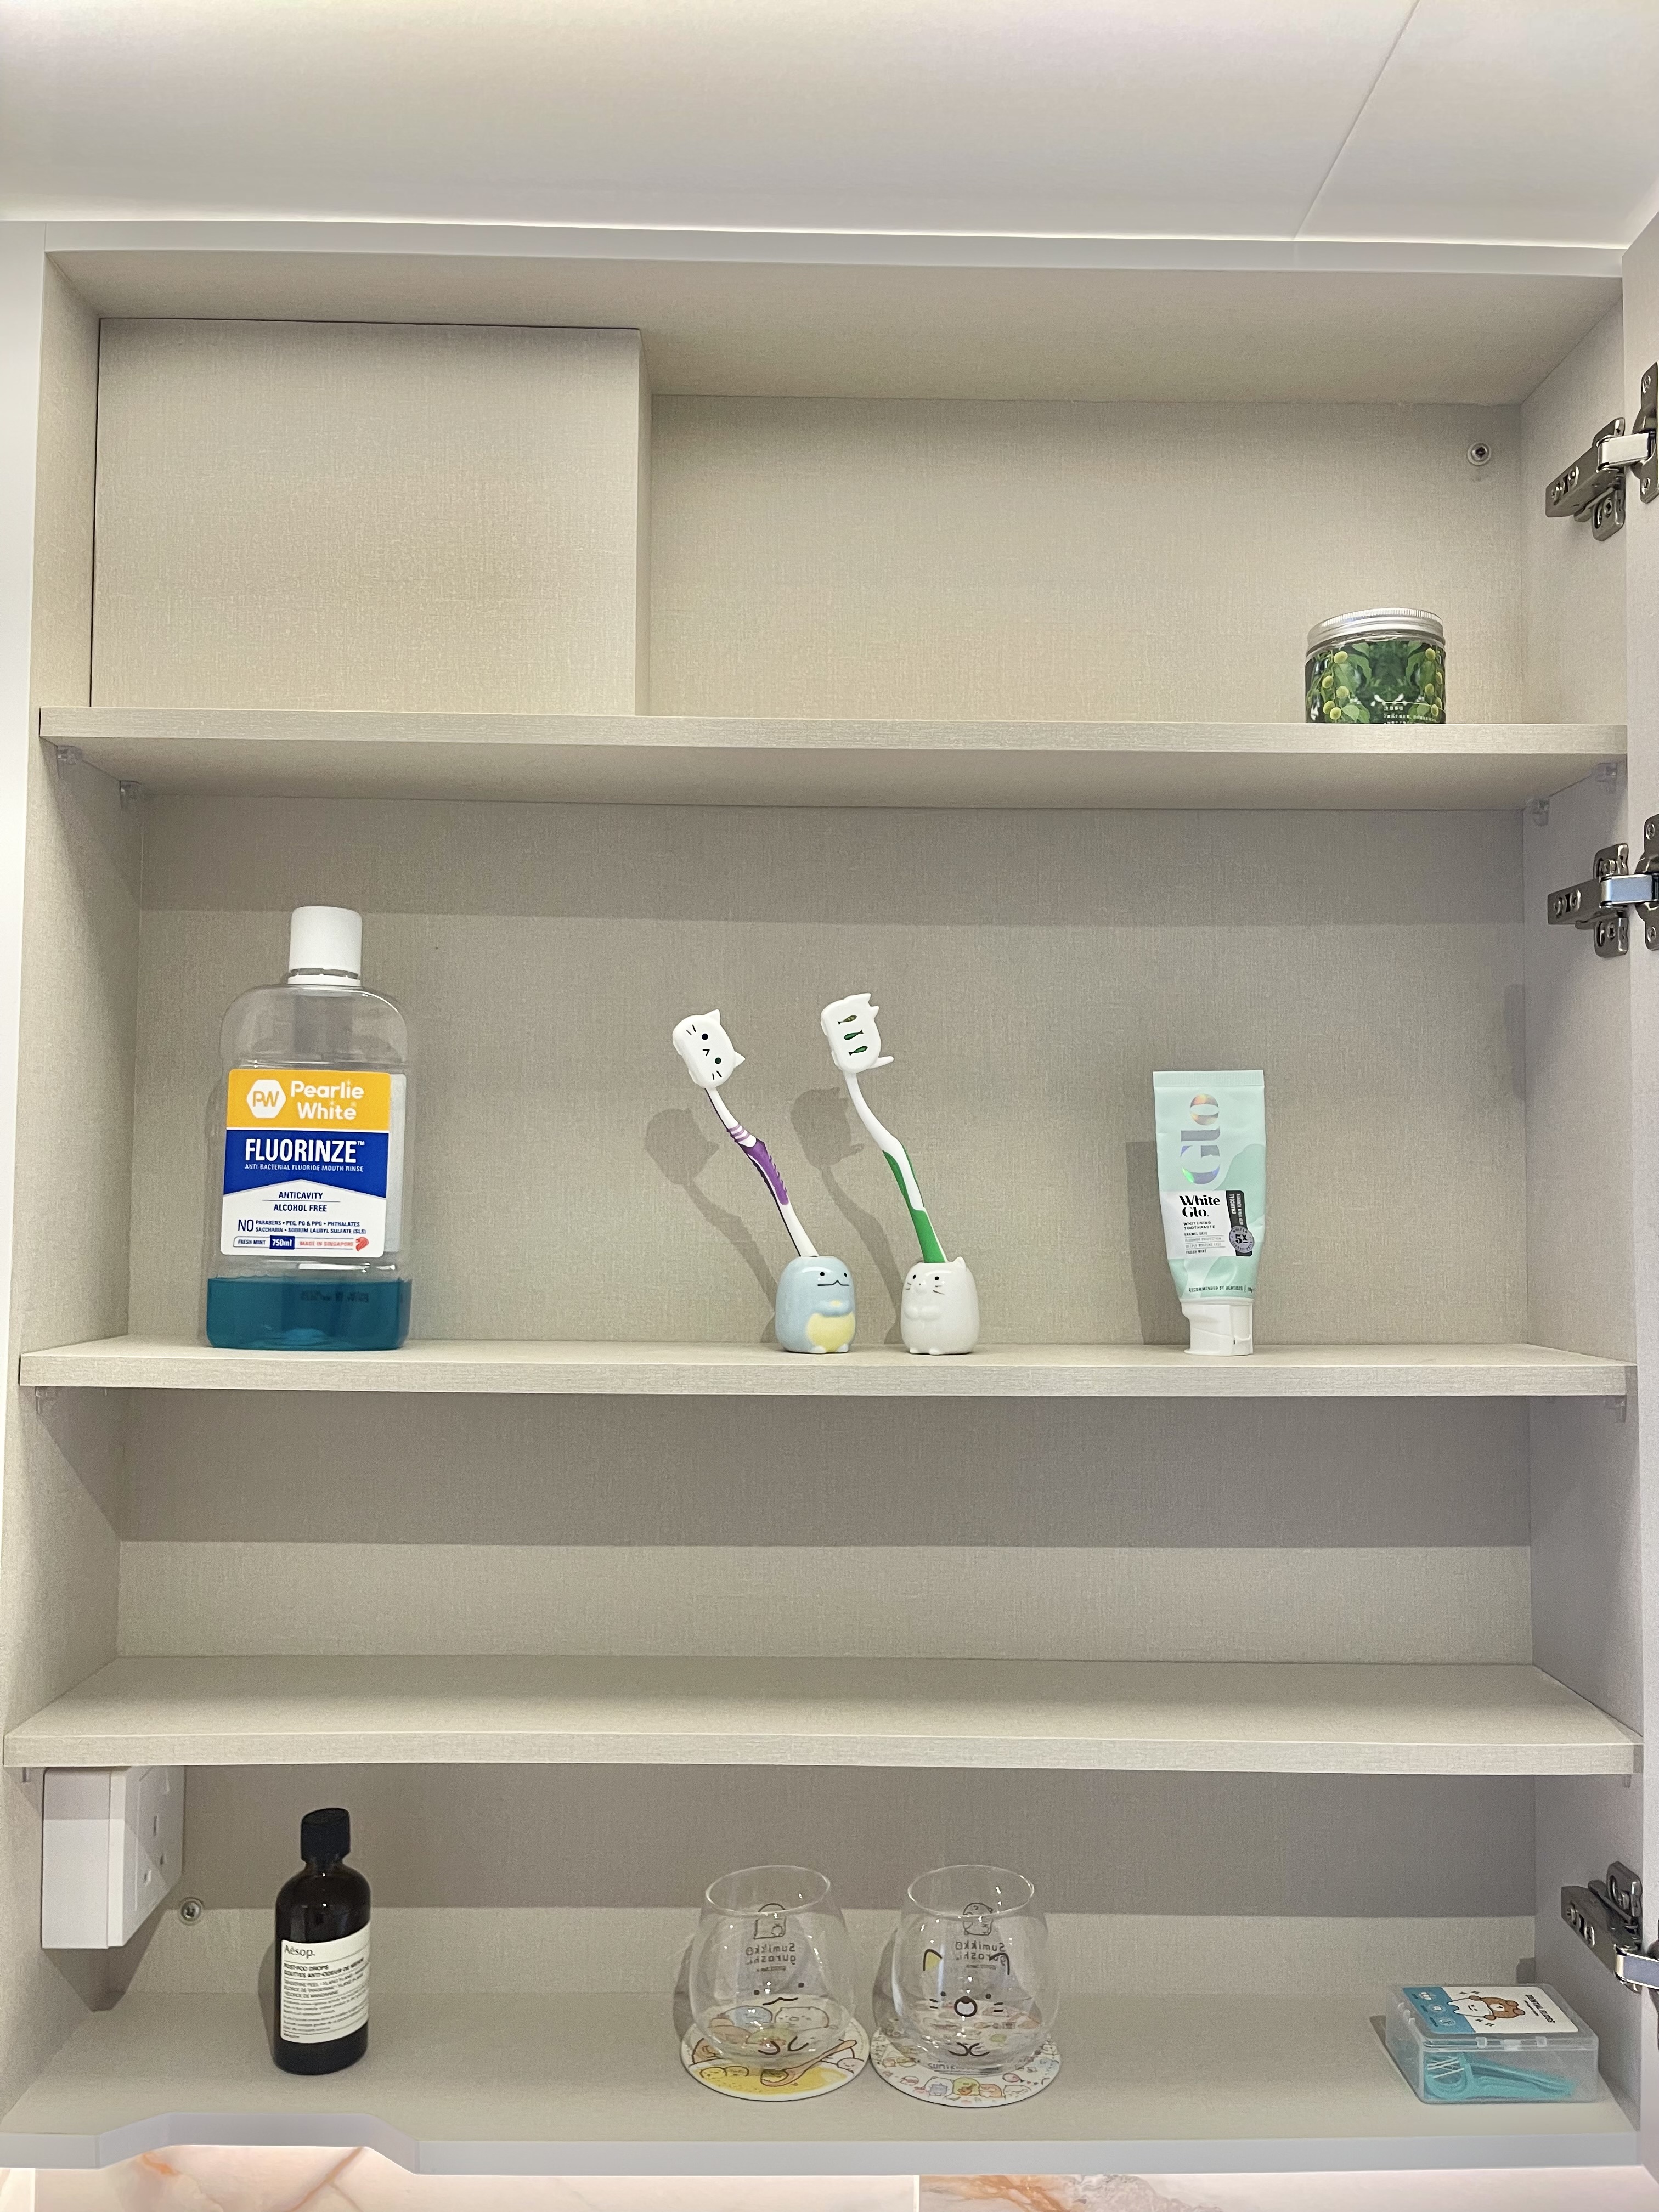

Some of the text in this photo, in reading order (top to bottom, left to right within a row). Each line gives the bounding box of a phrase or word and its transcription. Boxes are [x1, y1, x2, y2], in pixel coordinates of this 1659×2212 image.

[291, 1080, 364, 1099] Pearlie
[297, 1101, 357, 1120] White
[1179, 1195, 1221, 1206] White
[238, 1219, 254, 1232] NO
